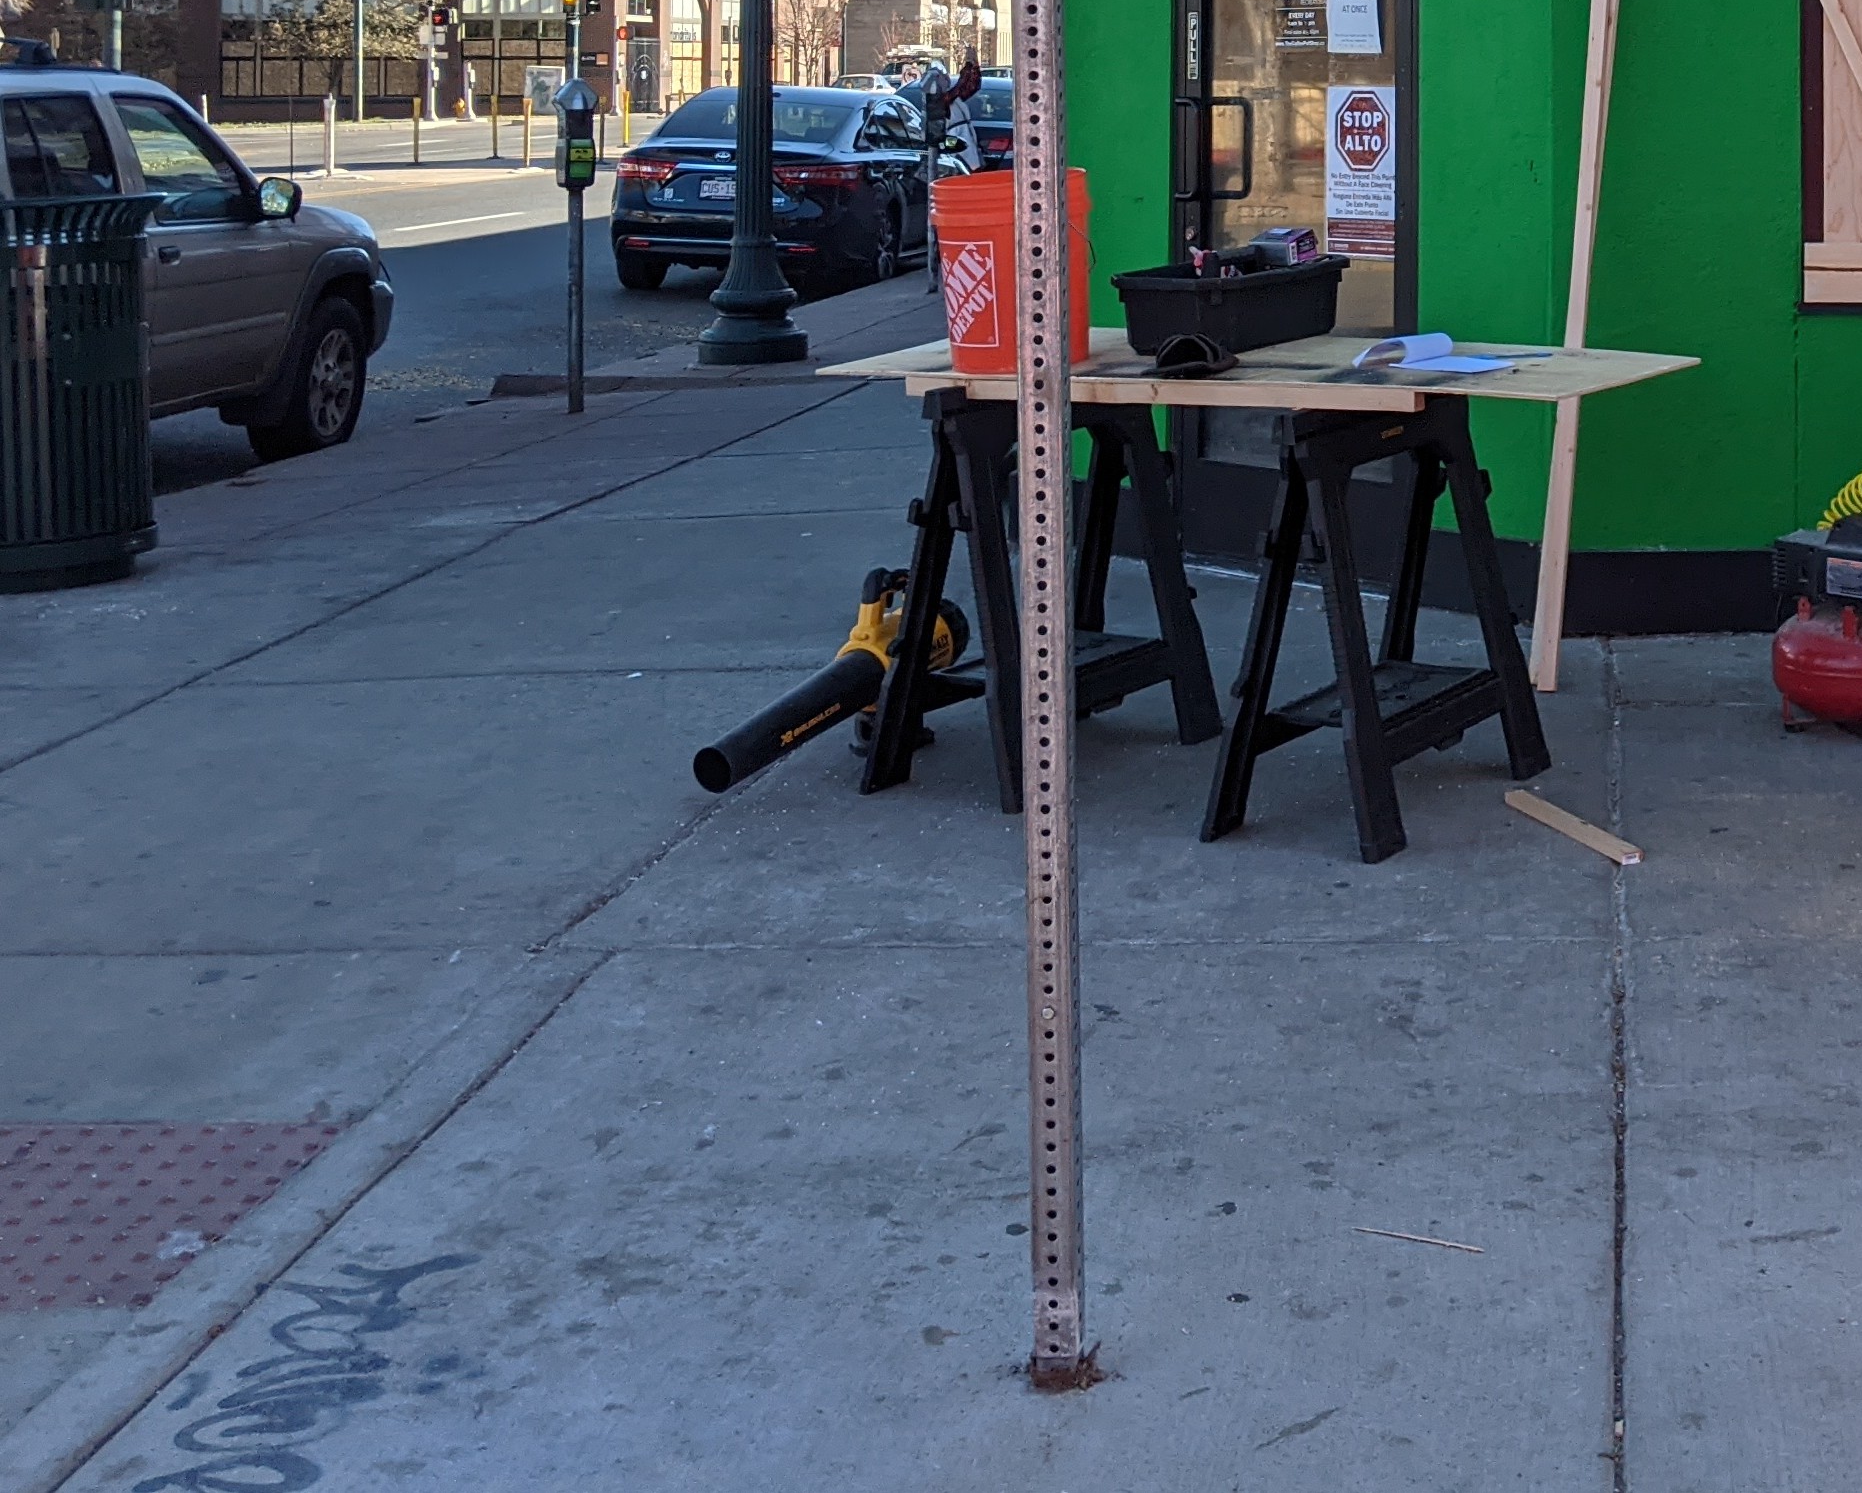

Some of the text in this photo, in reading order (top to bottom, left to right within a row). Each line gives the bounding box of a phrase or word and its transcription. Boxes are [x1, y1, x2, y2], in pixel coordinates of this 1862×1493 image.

[1342, 4, 1368, 13] AT ONCE
[1342, 111, 1383, 127] STOP
[1344, 135, 1382, 151] ALTO
[952, 282, 994, 343] DEPOT
